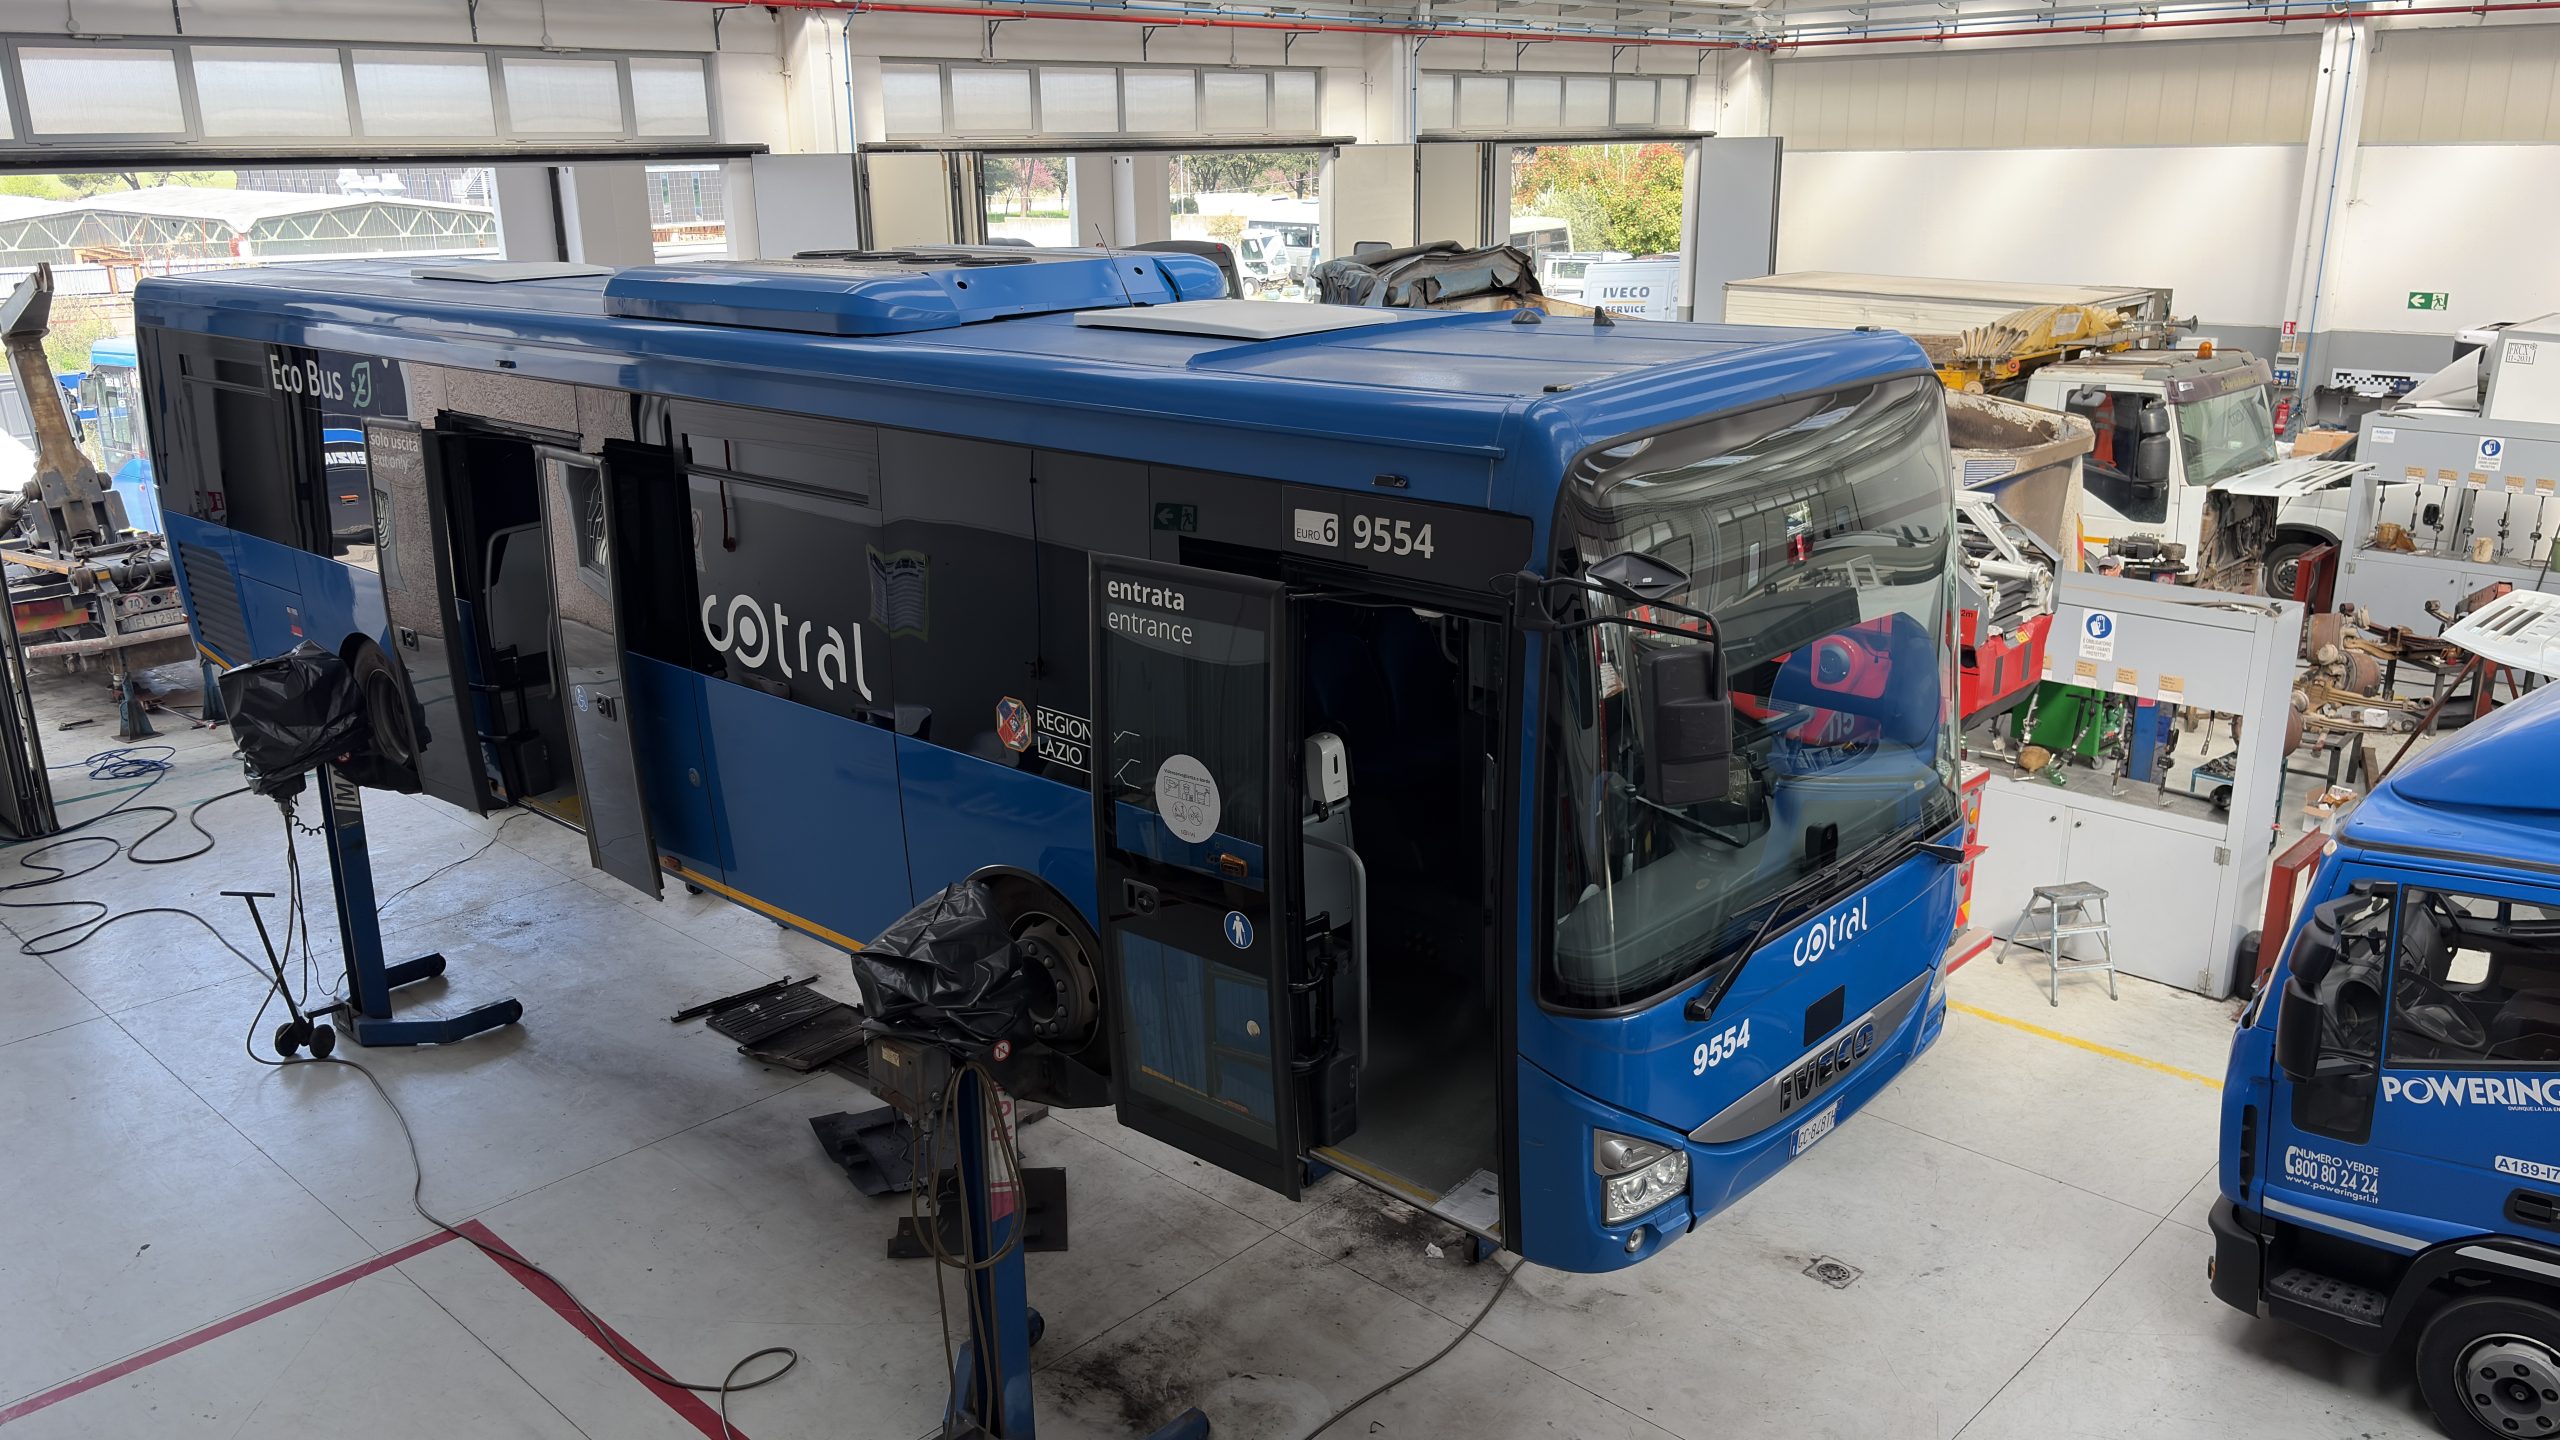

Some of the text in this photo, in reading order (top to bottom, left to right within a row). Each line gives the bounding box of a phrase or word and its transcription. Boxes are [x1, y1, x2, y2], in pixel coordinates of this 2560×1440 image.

[1602, 286, 1650, 299] IVECO
[1604, 305, 1646, 314] SERVICE
[269, 354, 344, 401] Eco Bus
[369, 433, 418, 453] solo uscita
[1296, 518, 1336, 543] EURO 6
[1352, 514, 1435, 559] 9554
[1107, 580, 1185, 611] entrata
[1108, 611, 1193, 645] entrance
[701, 593, 872, 702] cotral
[1037, 736, 1083, 766] LAZIO
[1793, 896, 1868, 967] cotral
[1693, 1017, 1751, 1077] 9554
[1781, 1022, 1875, 1114] IVECO
[2294, 1158, 2378, 1196] 800 80 24 24
[2295, 1148, 2379, 1177] NUMERO VERDE
[2285, 1174, 2379, 1204] www.poweringsrl.it
